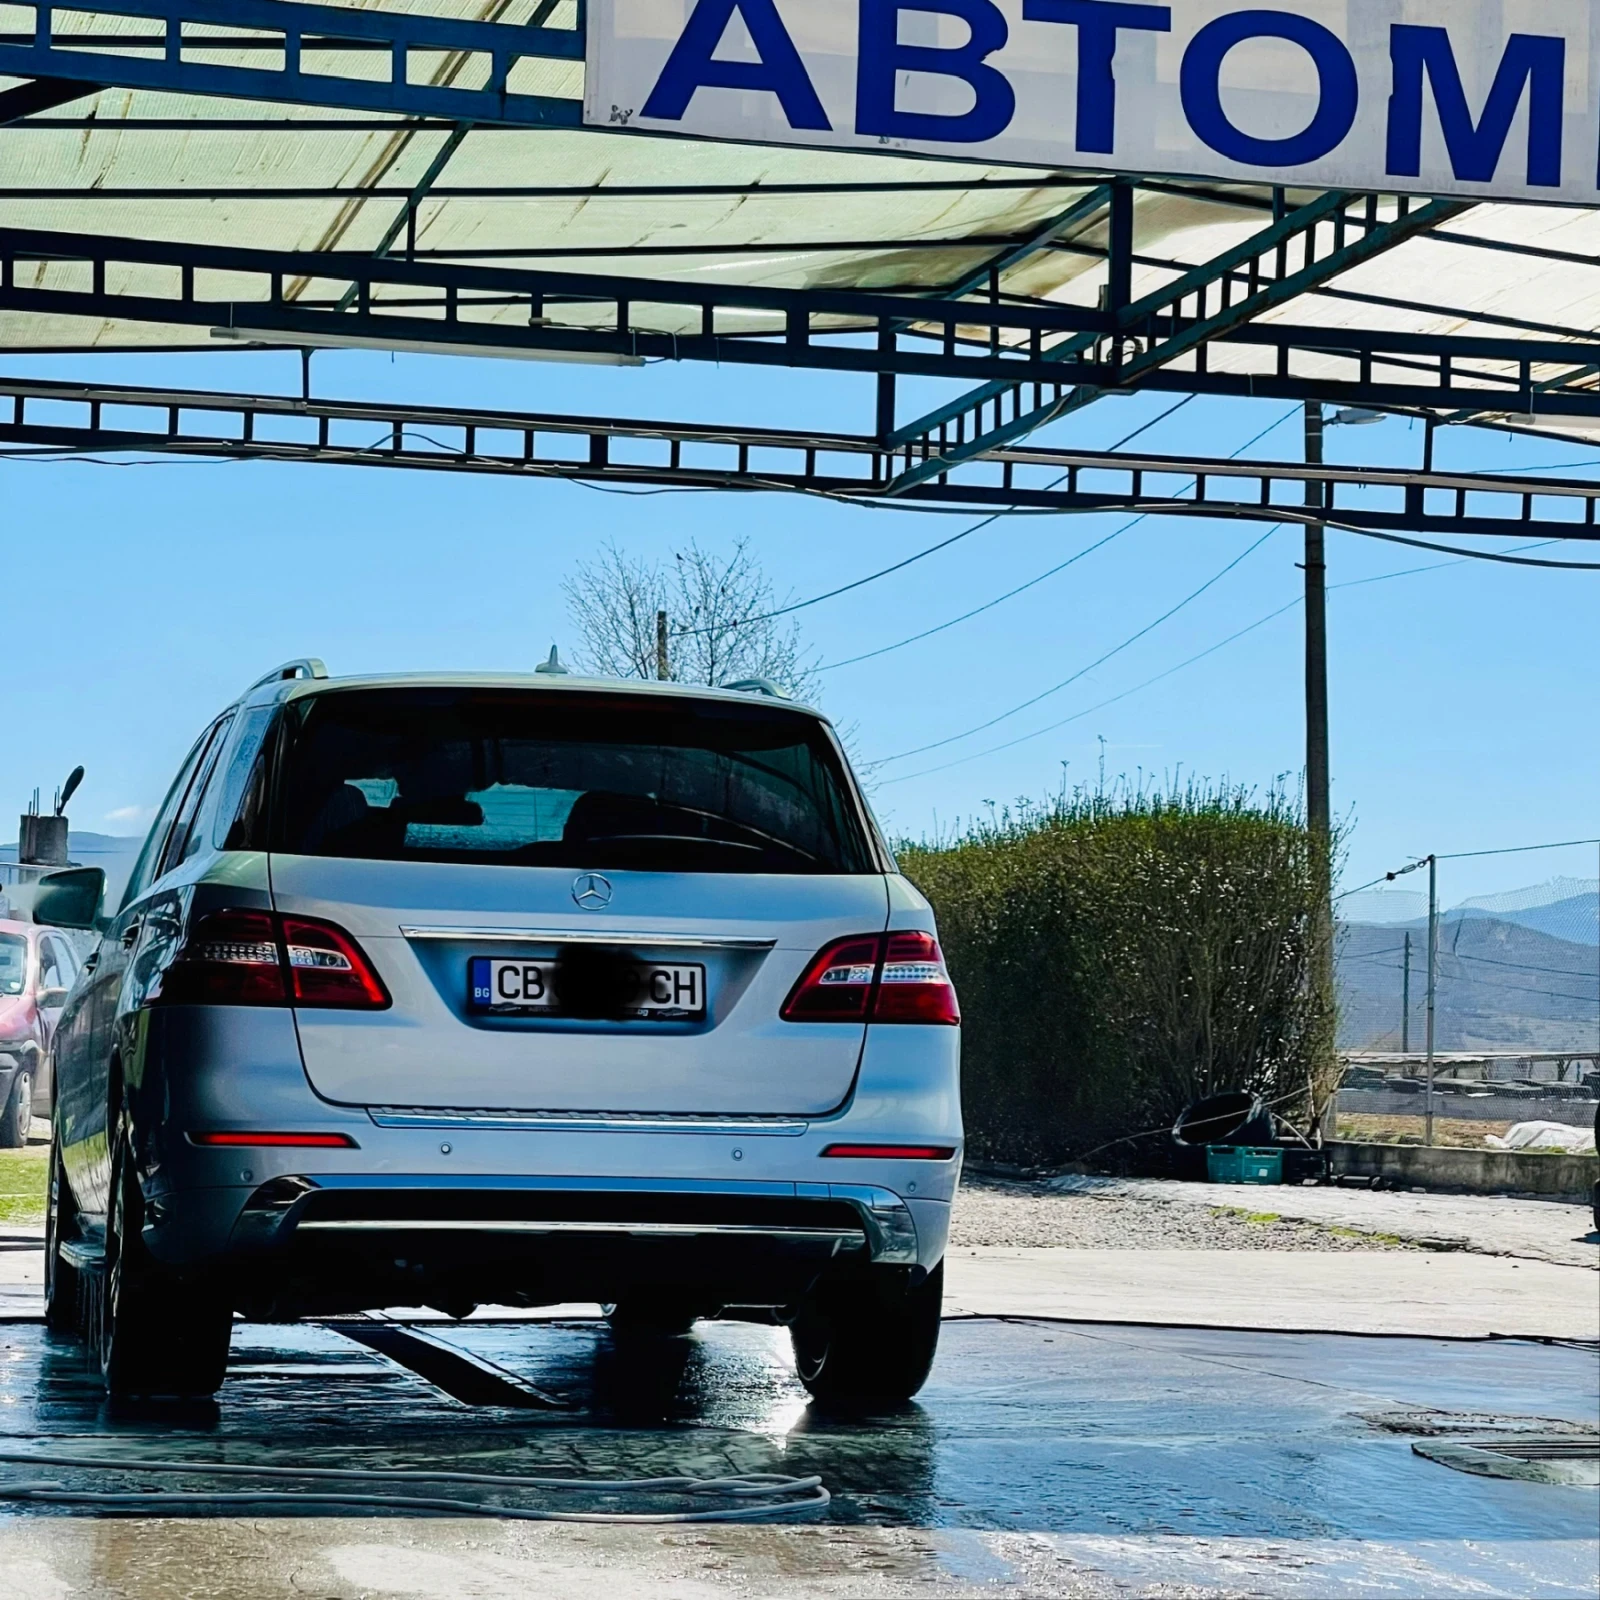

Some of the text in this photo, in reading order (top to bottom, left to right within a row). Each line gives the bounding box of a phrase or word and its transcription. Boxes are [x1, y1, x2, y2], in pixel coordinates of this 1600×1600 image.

[639, 0, 1600, 190] АВТОМ
[474, 987, 490, 998] BG
[498, 965, 545, 1000] CB
[649, 969, 696, 1006] CH
